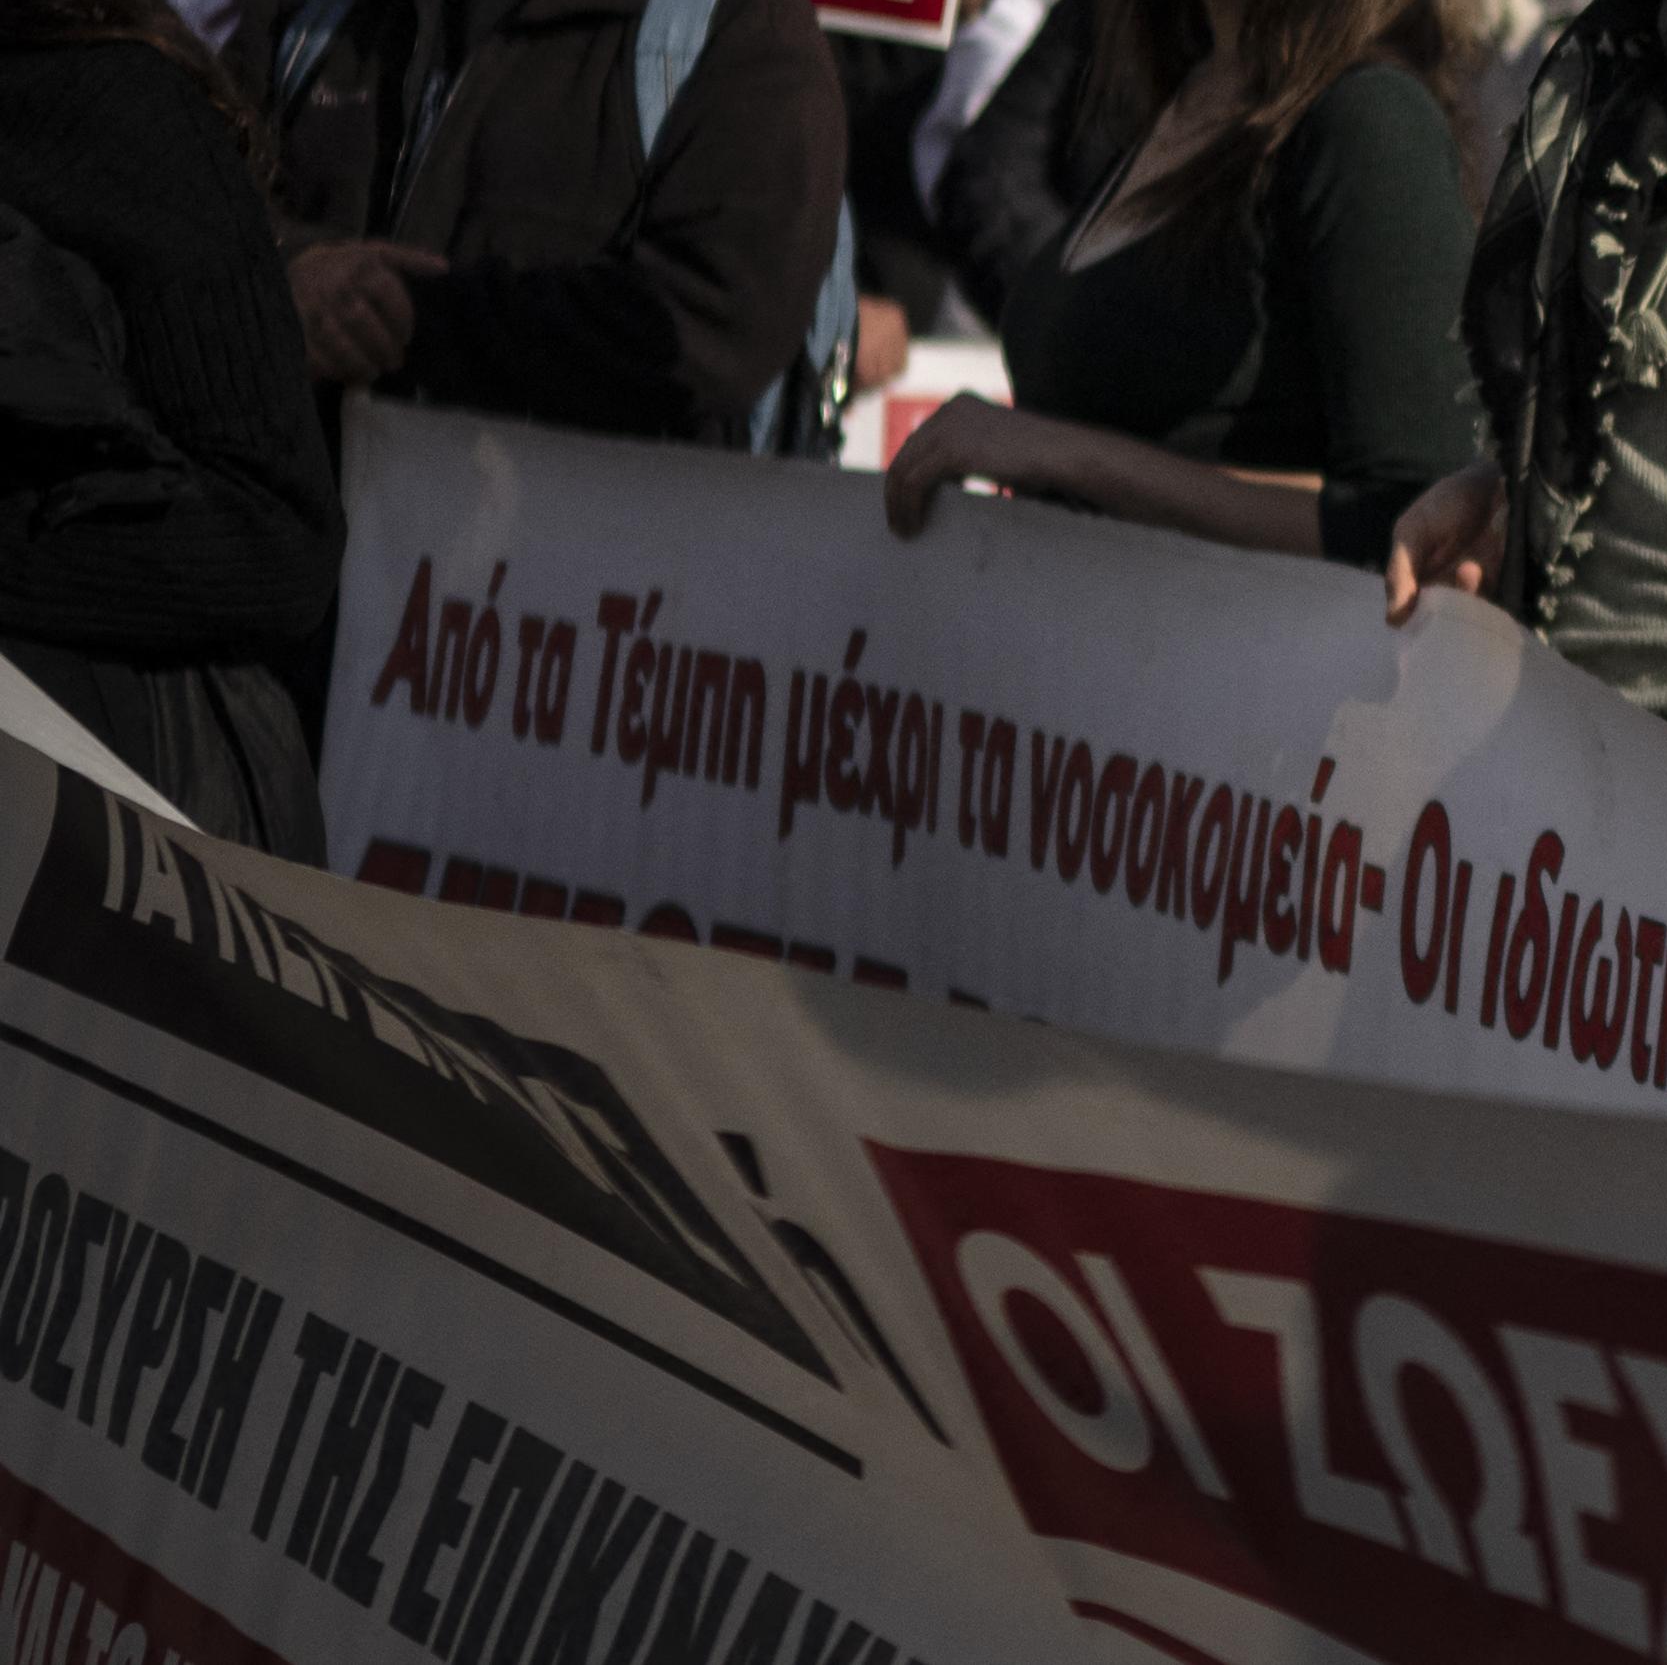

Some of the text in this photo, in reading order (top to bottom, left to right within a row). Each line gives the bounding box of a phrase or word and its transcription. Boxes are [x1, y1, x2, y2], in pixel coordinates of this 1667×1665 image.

[371, 555, 506, 730] Από
[514, 612, 578, 745] τα
[589, 588, 766, 810] Τέμπη
[778, 630, 945, 869] μέχρι
[954, 707, 1018, 858] τα
[1400, 801, 1473, 1014] Οι
[252, 1311, 445, 1609] ΤΗΣ
[957, 1227, 1233, 1502] ΟΙ
